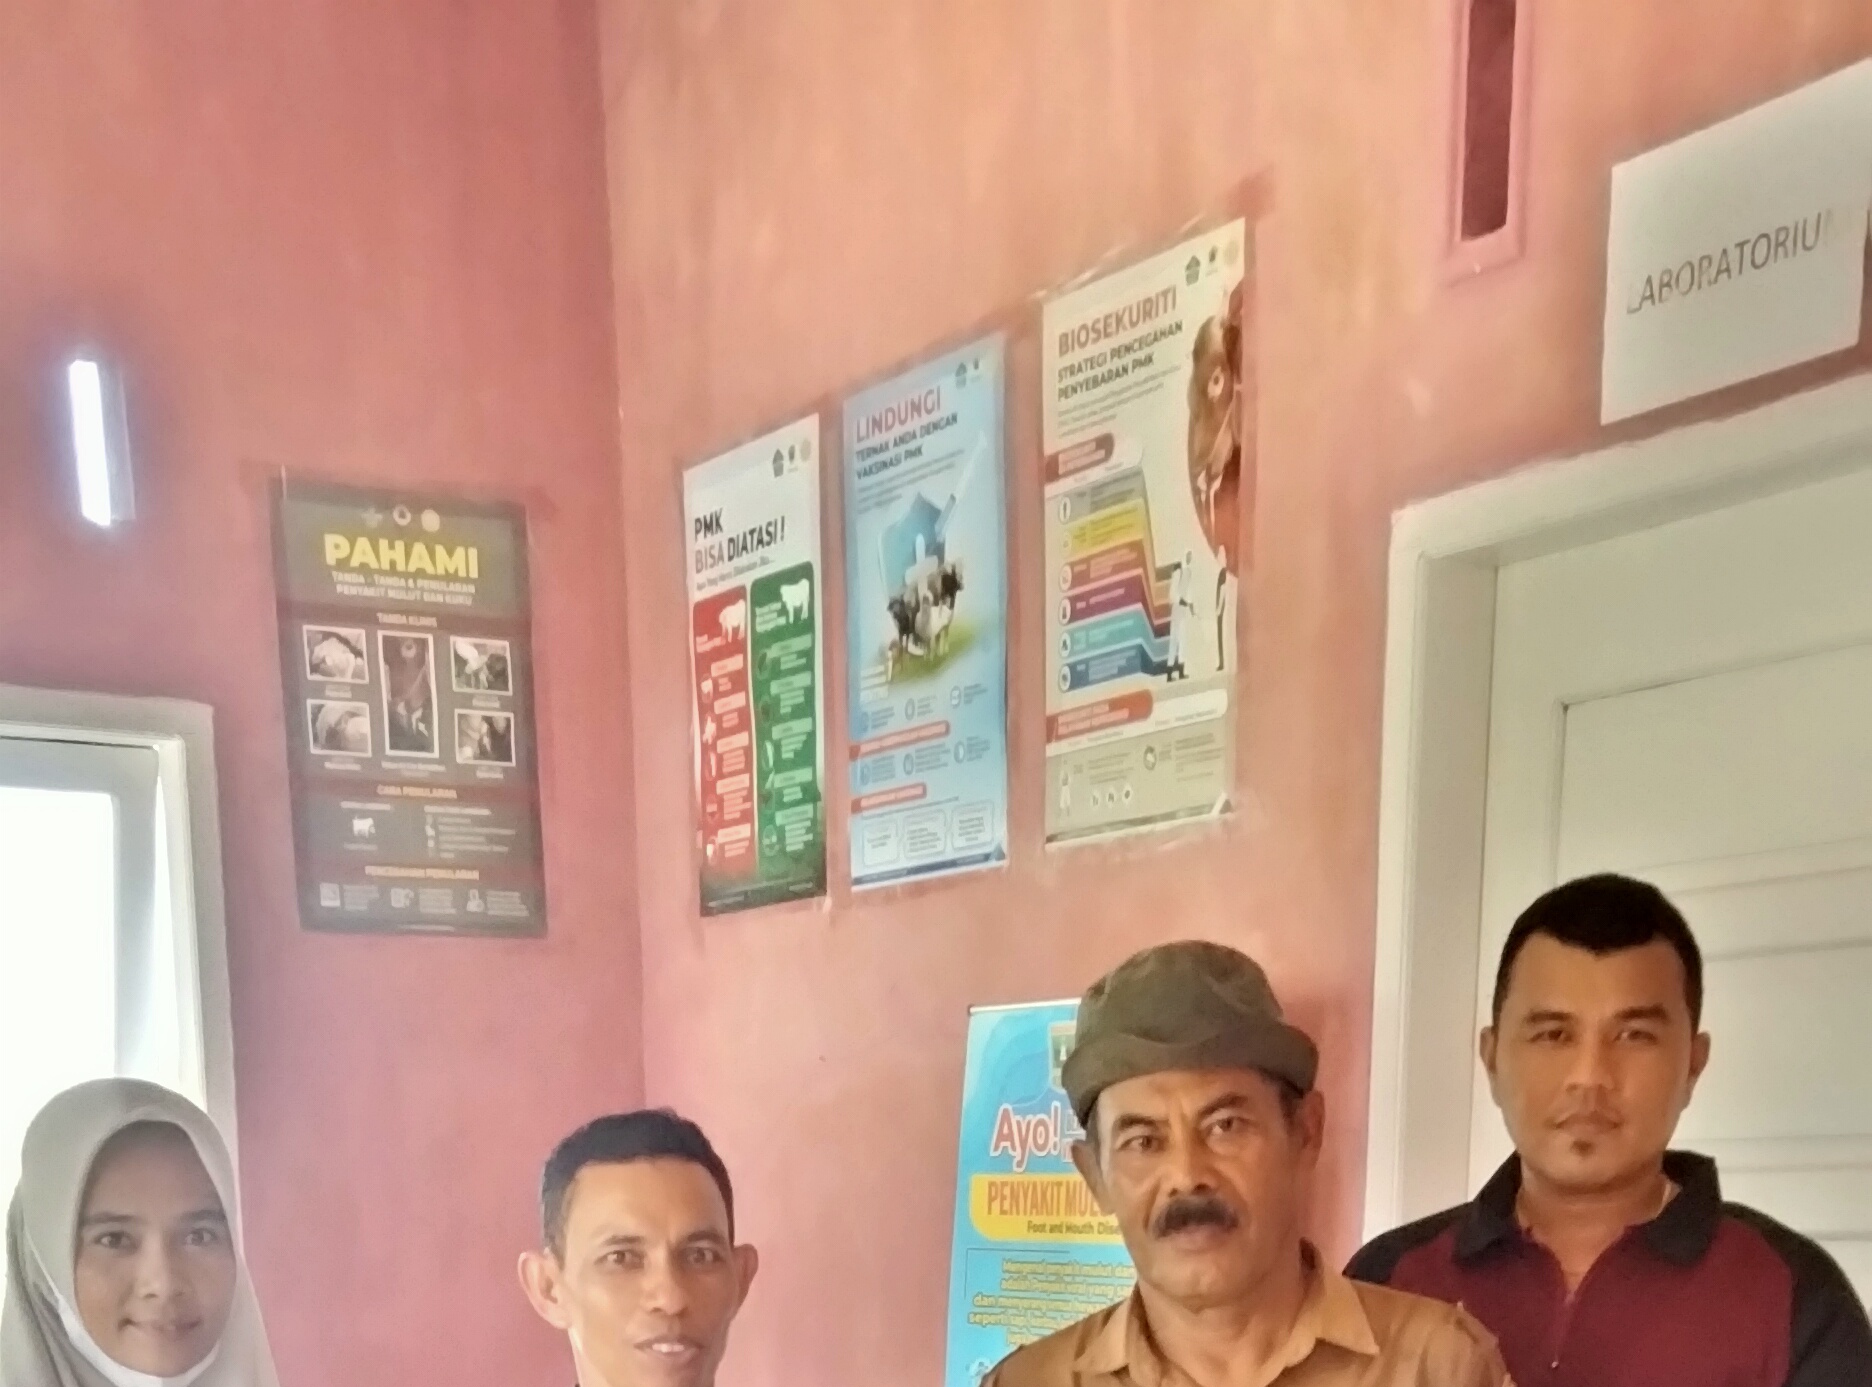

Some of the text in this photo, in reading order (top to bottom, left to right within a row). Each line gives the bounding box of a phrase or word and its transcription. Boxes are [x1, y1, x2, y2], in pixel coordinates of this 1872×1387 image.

[1626, 207, 1834, 315] LABORATORIU
[1059, 284, 1177, 358] BIOSEKURITI
[1058, 319, 1183, 384] STRATEGI PENCEGAHAN
[1058, 362, 1129, 402] PENYEBARAN
[1131, 352, 1154, 374] PMK
[856, 412, 958, 462] TERNAK ANDA DENGAN
[857, 385, 941, 443] LINDUNGI
[856, 443, 923, 480] VAKSINASI PMK
[694, 507, 723, 542] PMK
[695, 540, 725, 574] BISA
[727, 518, 778, 562] DIATASI
[324, 533, 479, 579] PAHAMI
[332, 570, 365, 583] TANDA
[373, 573, 407, 587] TANDA
[990, 1101, 1061, 1173] Ayo!
[987, 1180, 1100, 1217] PENYAKIT MUL
[1027, 1220, 1121, 1236] Foot and Mouth Dise
